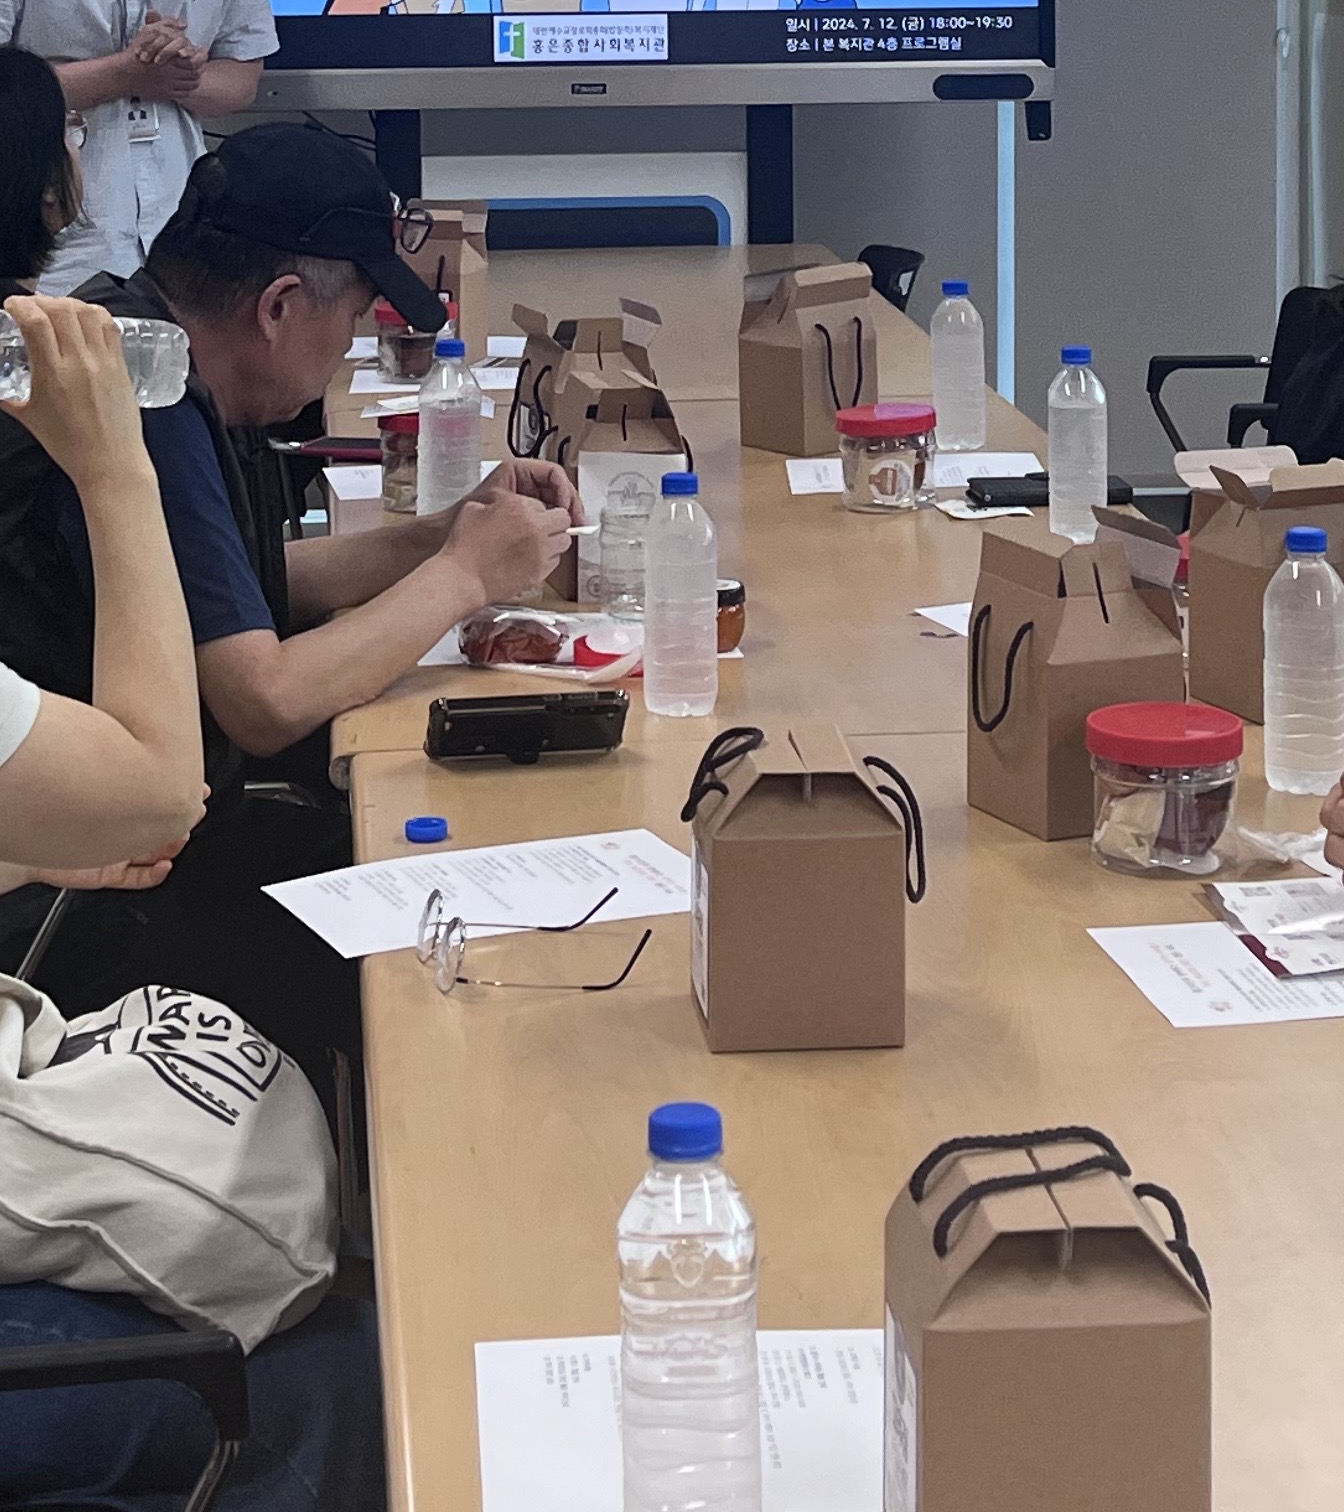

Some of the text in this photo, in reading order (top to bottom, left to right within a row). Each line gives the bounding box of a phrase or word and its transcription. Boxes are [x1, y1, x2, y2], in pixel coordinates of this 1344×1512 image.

[785, 17, 811, 33] 일시
[821, 17, 859, 32] 2024.
[901, 16, 925, 31] (금)
[928, 16, 1014, 30] 18:00~19:30
[532, 37, 666, 54] 홍은종합사회복지관
[785, 37, 812, 52] 장소
[822, 37, 835, 51] 본
[837, 36, 875, 52] 복지관
[877, 36, 899, 51] 4층
[901, 35, 963, 51] 프로그램실
